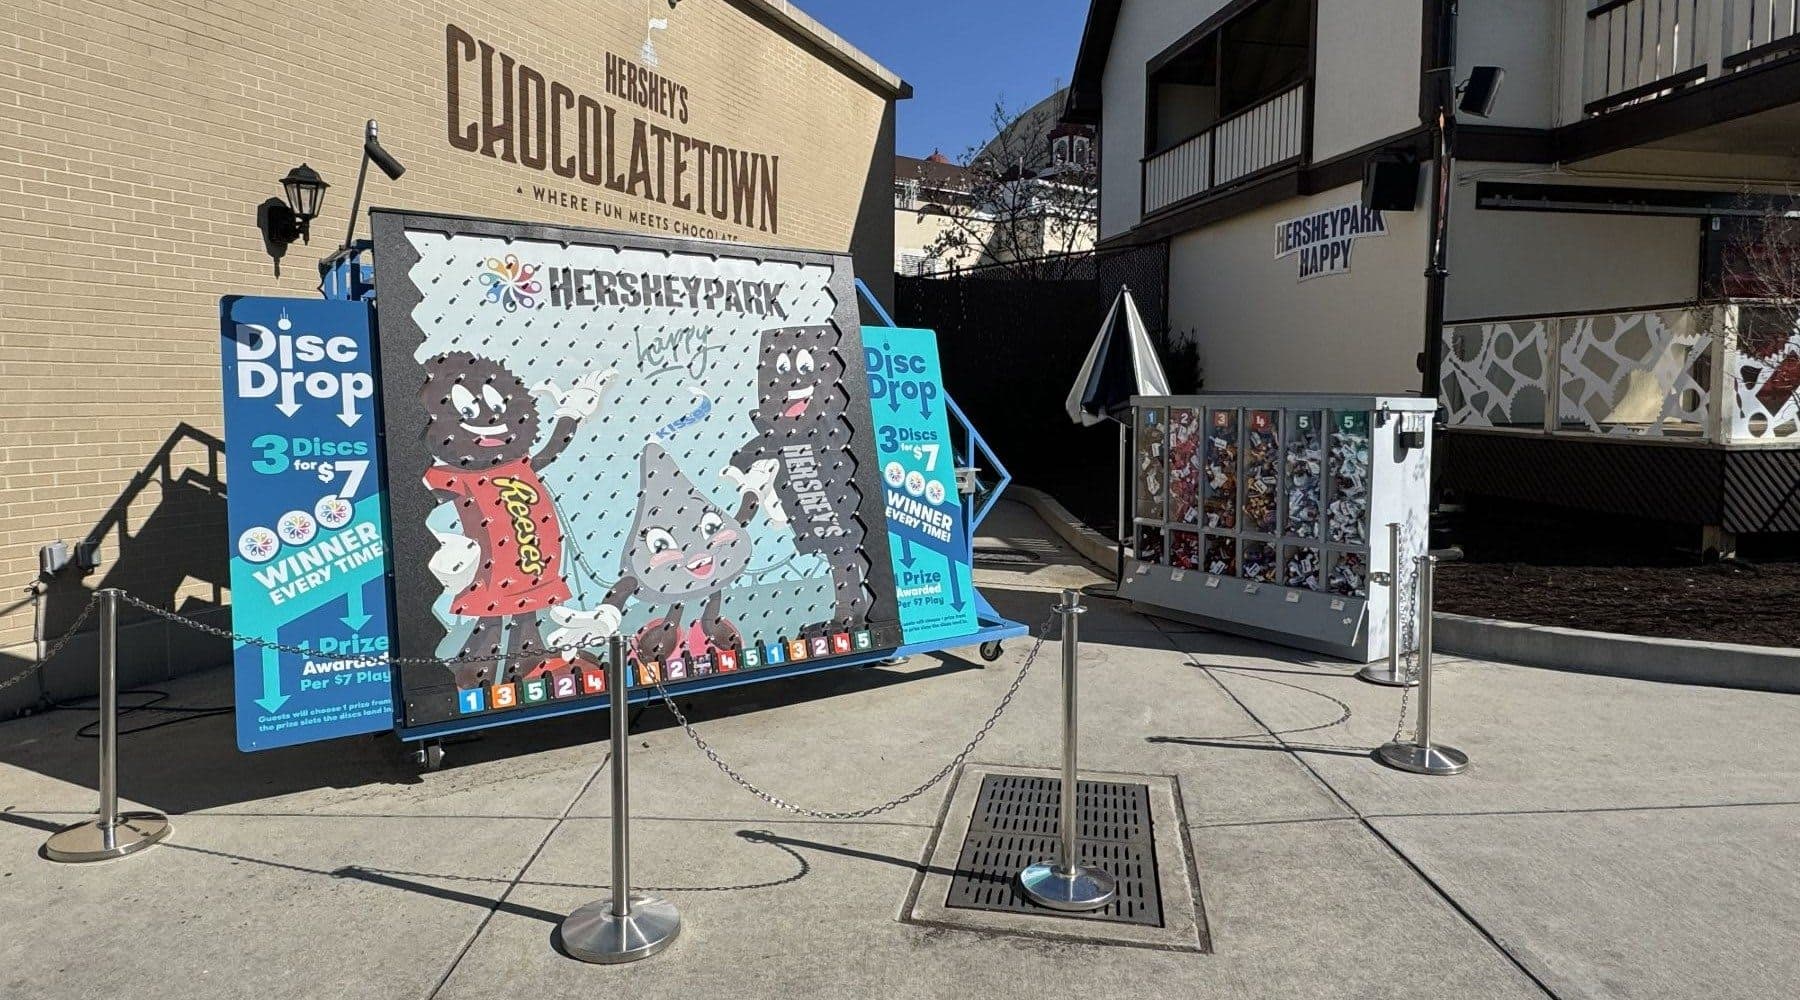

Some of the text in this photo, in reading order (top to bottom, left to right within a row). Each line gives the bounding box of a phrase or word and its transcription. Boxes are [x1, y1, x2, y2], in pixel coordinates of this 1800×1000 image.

[605, 51, 688, 124] HERSHEY'S
[446, 23, 779, 235] CHOCOLATETOWN
[533, 185, 588, 211] WHERE
[596, 202, 622, 220] FUN
[628, 210, 669, 230] MEETS
[1276, 204, 1384, 255] HERSHEYPARK
[1300, 238, 1352, 278] HAPPY
[549, 266, 787, 318] HERSHEYPARK
[236, 318, 358, 369] Disc
[863, 342, 926, 378] Disc
[237, 361, 374, 427] Drop
[867, 374, 937, 420] Drop
[1148, 411, 1154, 422] 1
[1181, 412, 1188, 424] 2
[1218, 414, 1226, 424] 3
[1256, 416, 1265, 428] 4
[1299, 416, 1308, 428] 5
[1344, 416, 1354, 428] 5
[878, 426, 938, 453] 3 Discs
[251, 434, 368, 475] 3 Discs
[901, 442, 940, 472] for $7
[293, 460, 370, 499] for $7
[783, 444, 843, 537] HERSHEY'S
[887, 490, 953, 532] WINNER
[885, 506, 951, 543] EVERY TIME!
[252, 521, 380, 590] WINNER
[268, 541, 384, 606] EVERY TIME
[903, 570, 942, 586] Prize
[925, 596, 944, 606] Play
[320, 634, 388, 656] Prize
[793, 643, 804, 658] 3
[815, 637, 827, 653] 2
[836, 635, 848, 650] 4
[858, 633, 869, 648] 5
[720, 654, 736, 669] 4
[746, 652, 758, 666] 5
[771, 648, 780, 662] 1
[670, 662, 684, 678] 2
[300, 670, 391, 692] Per $7 Play
[528, 682, 544, 700] 5
[558, 677, 574, 696] 2
[587, 674, 602, 690] 4
[466, 692, 477, 712] 1
[497, 686, 512, 705] 3
[258, 714, 291, 723] Guests
[292, 710, 308, 718] will
[310, 706, 342, 716] choose
[348, 702, 370, 712] prize
[259, 724, 275, 732] the
[276, 721, 299, 732] prize
[300, 717, 322, 726] slots
[323, 714, 338, 722] the
[340, 710, 361, 720] discs
[363, 708, 382, 716] land
